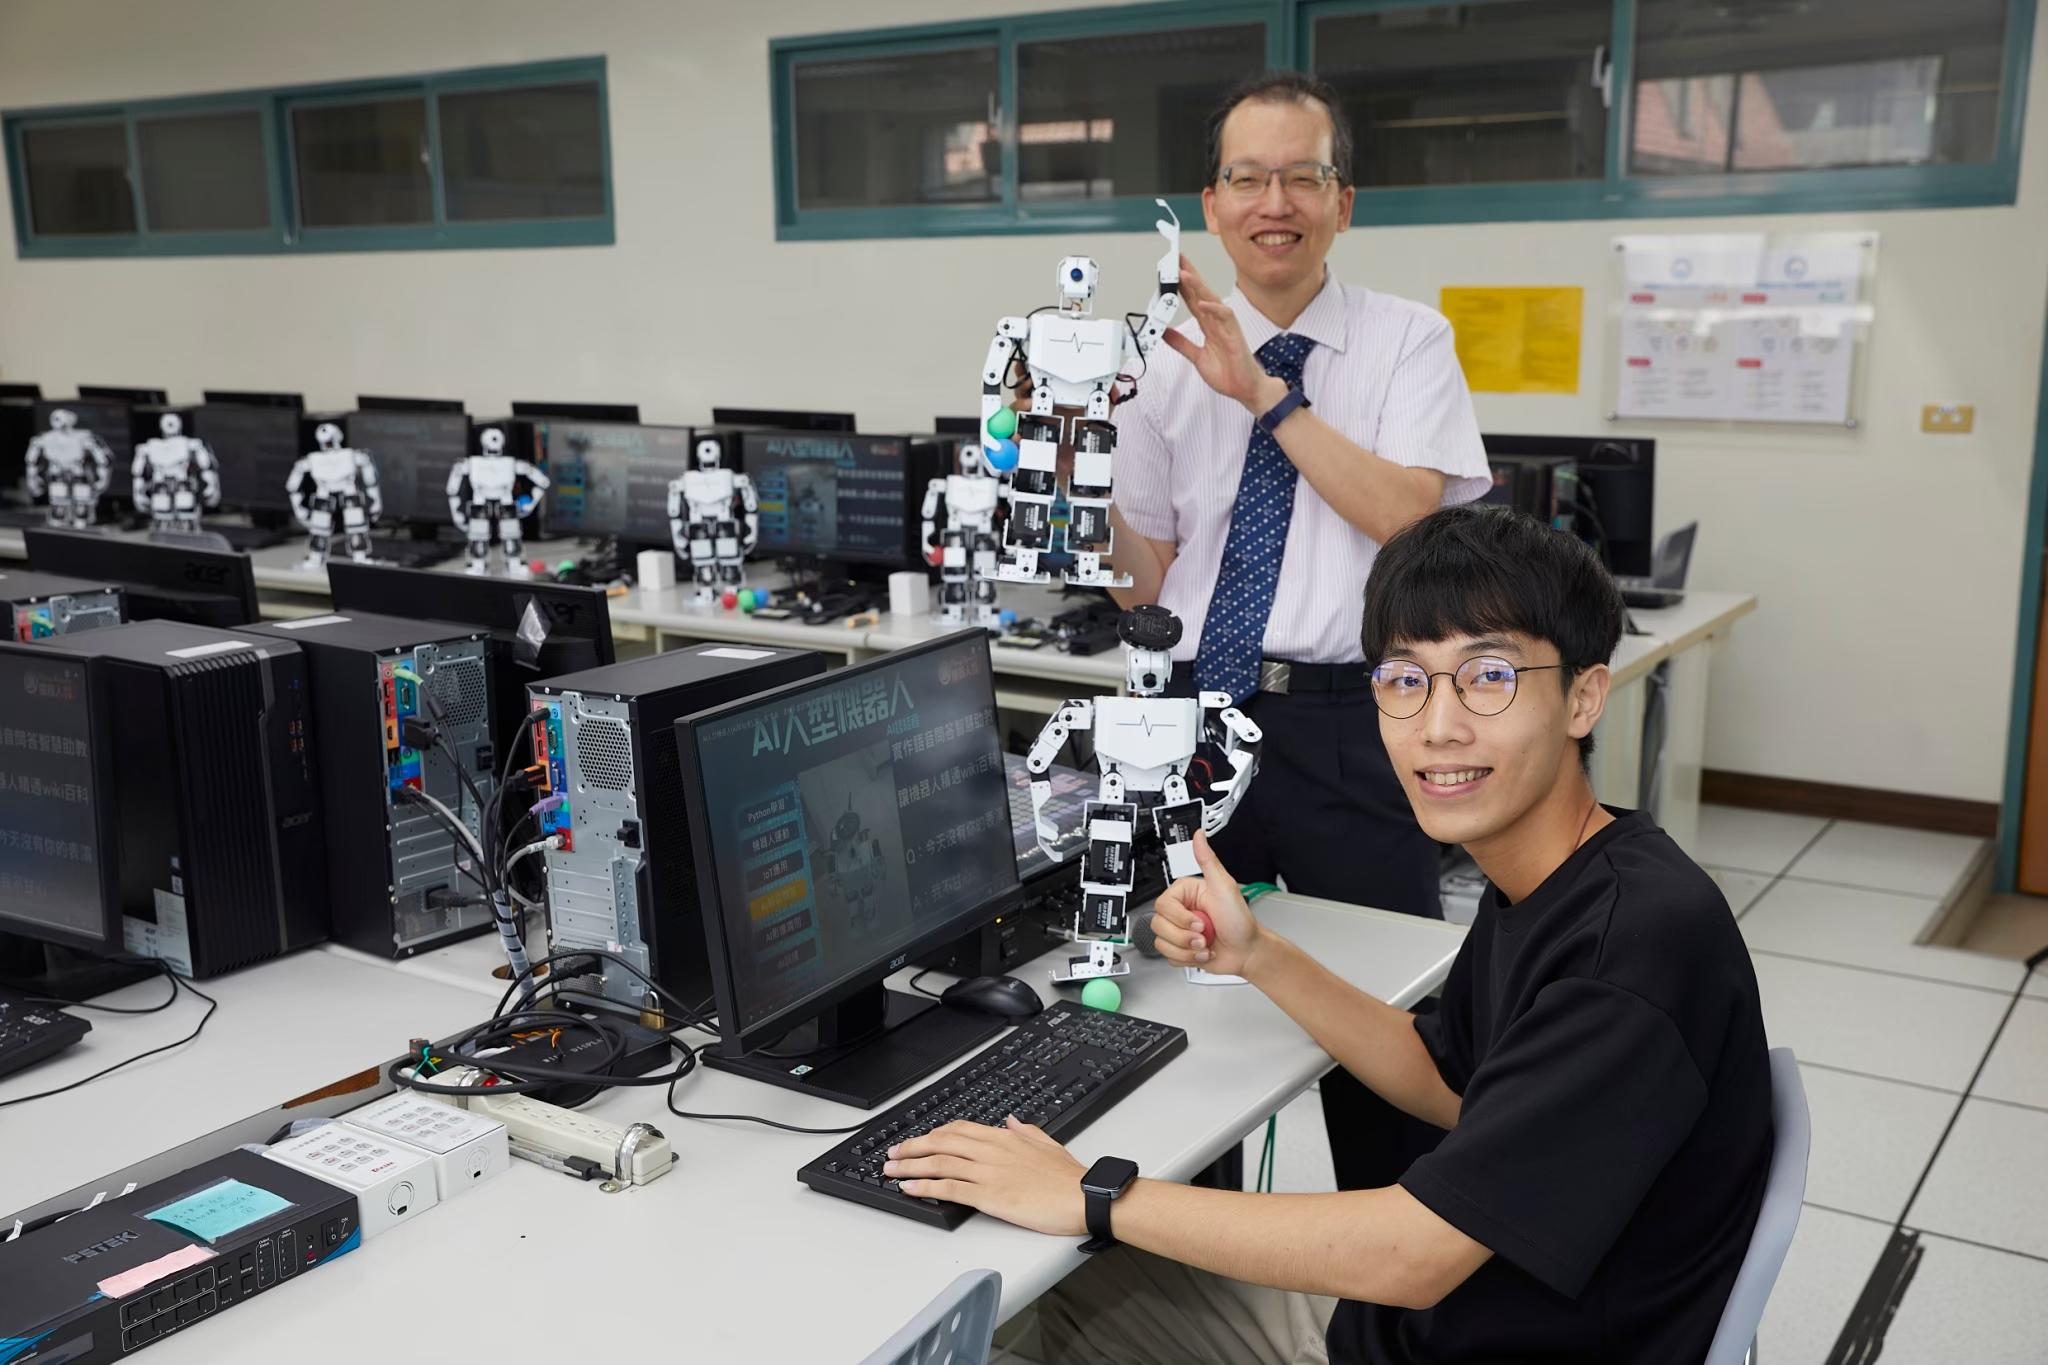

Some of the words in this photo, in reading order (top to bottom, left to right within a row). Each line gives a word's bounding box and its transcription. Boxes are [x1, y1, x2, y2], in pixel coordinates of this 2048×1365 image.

[752, 672, 914, 757] AI人型機器人
[889, 953, 907, 970] acer
